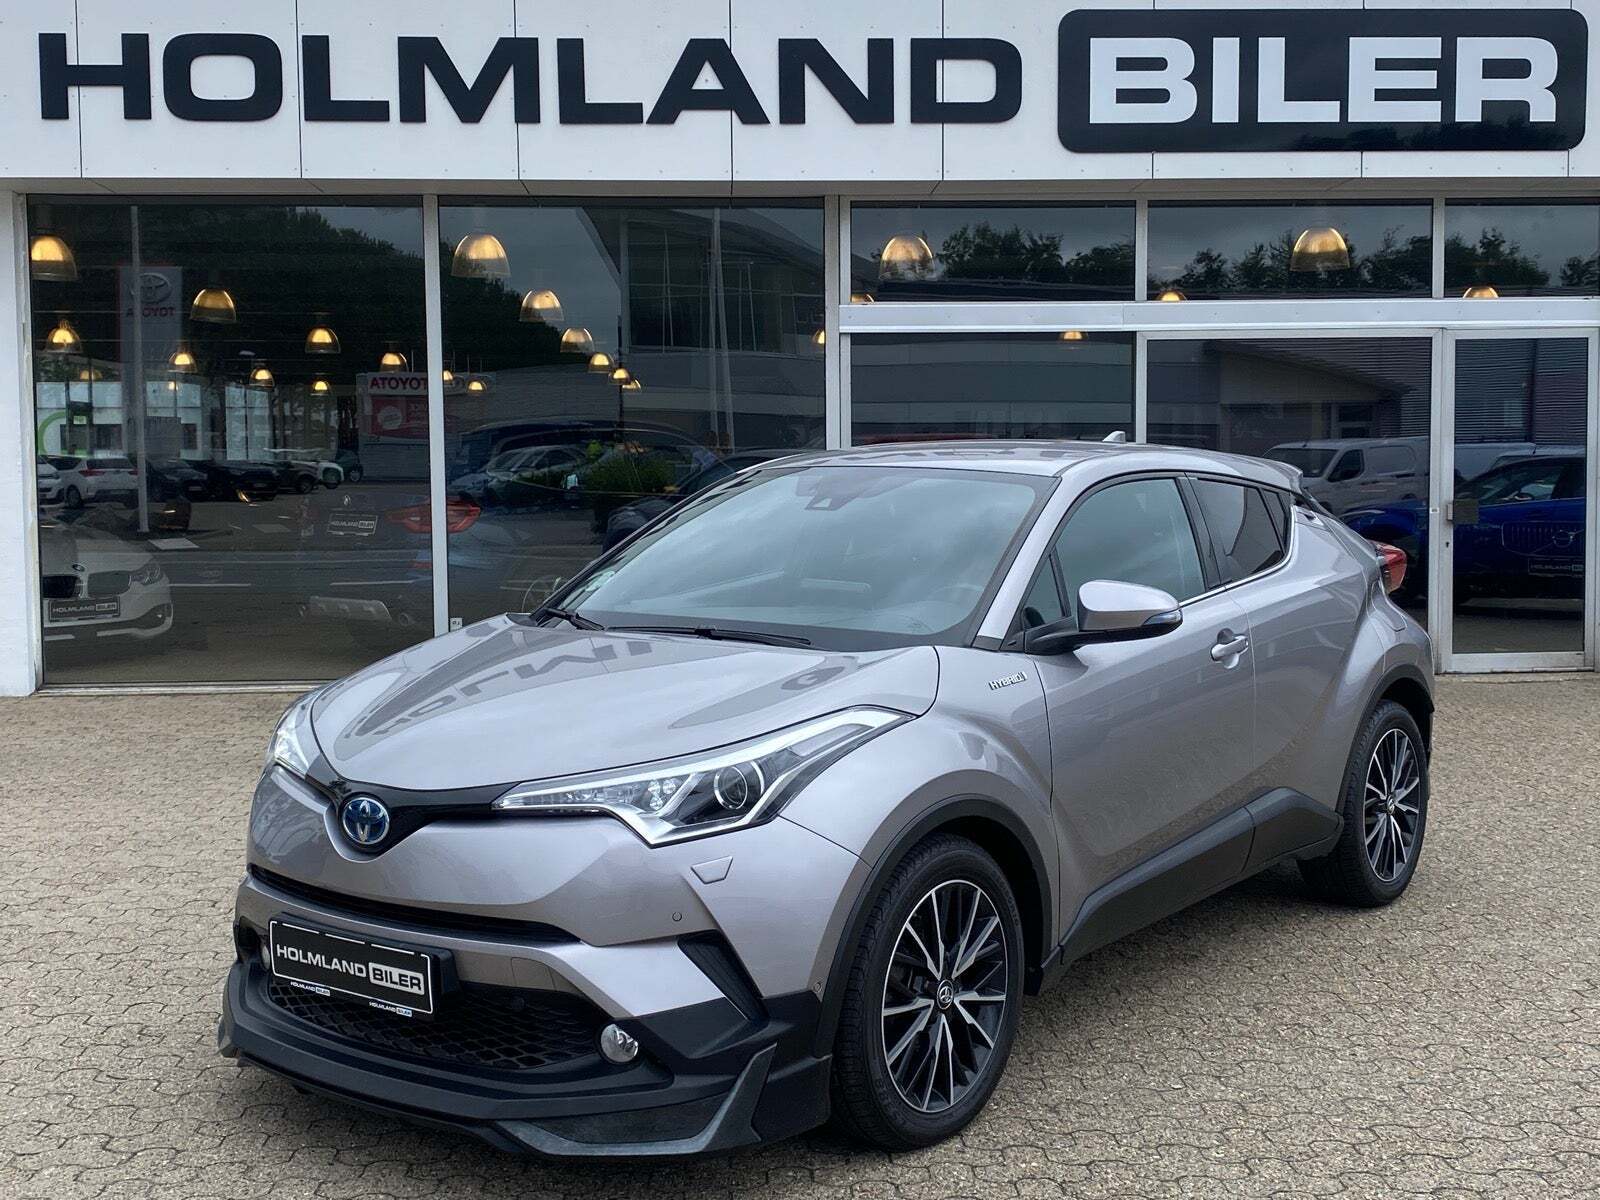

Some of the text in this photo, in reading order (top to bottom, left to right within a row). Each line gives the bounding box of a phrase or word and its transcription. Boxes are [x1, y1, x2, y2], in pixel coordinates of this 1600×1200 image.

[38, 32, 1559, 125] HOLMLAND BILER
[988, 671, 1026, 690] HYBRID
[276, 943, 423, 992] HOLMLAND BILER
[290, 981, 316, 992] HOLMLAND
[368, 1001, 396, 1012] HOLMLAND
